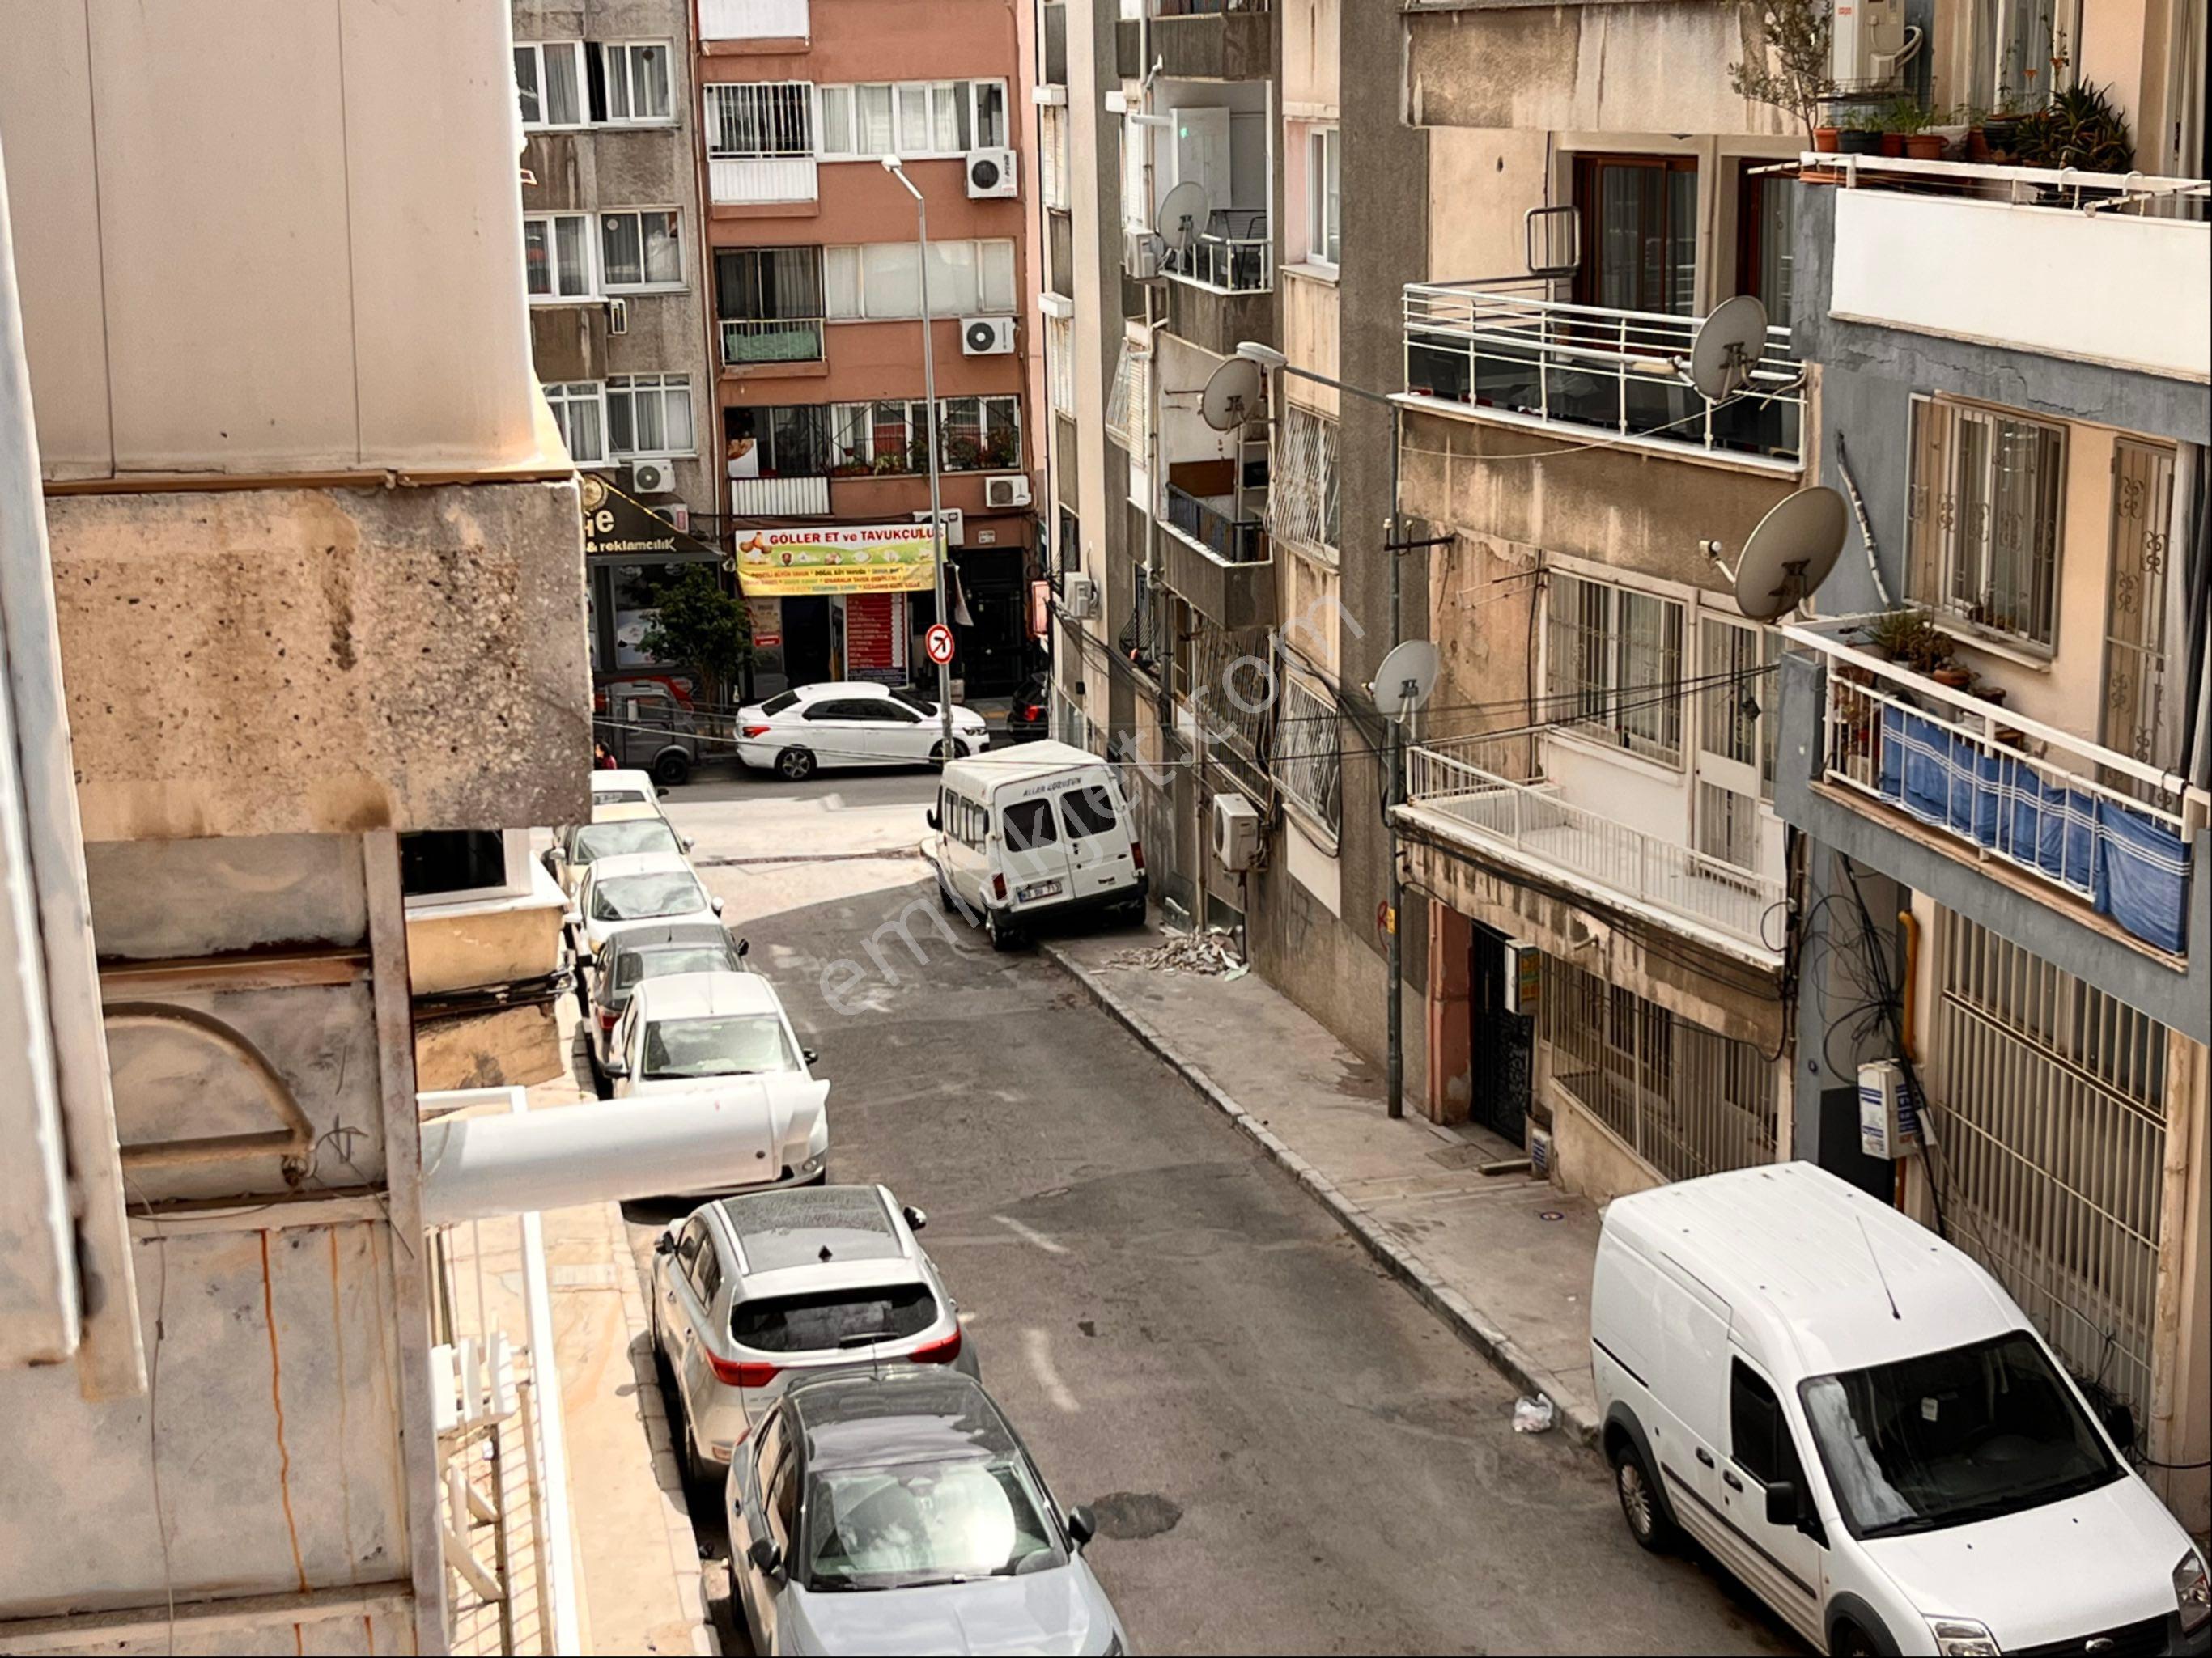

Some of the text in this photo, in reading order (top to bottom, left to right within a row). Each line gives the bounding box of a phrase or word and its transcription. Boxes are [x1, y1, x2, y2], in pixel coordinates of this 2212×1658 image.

[770, 532, 821, 545] GÖLLER
[825, 532, 839, 542] ET
[843, 533, 858, 542] ve
